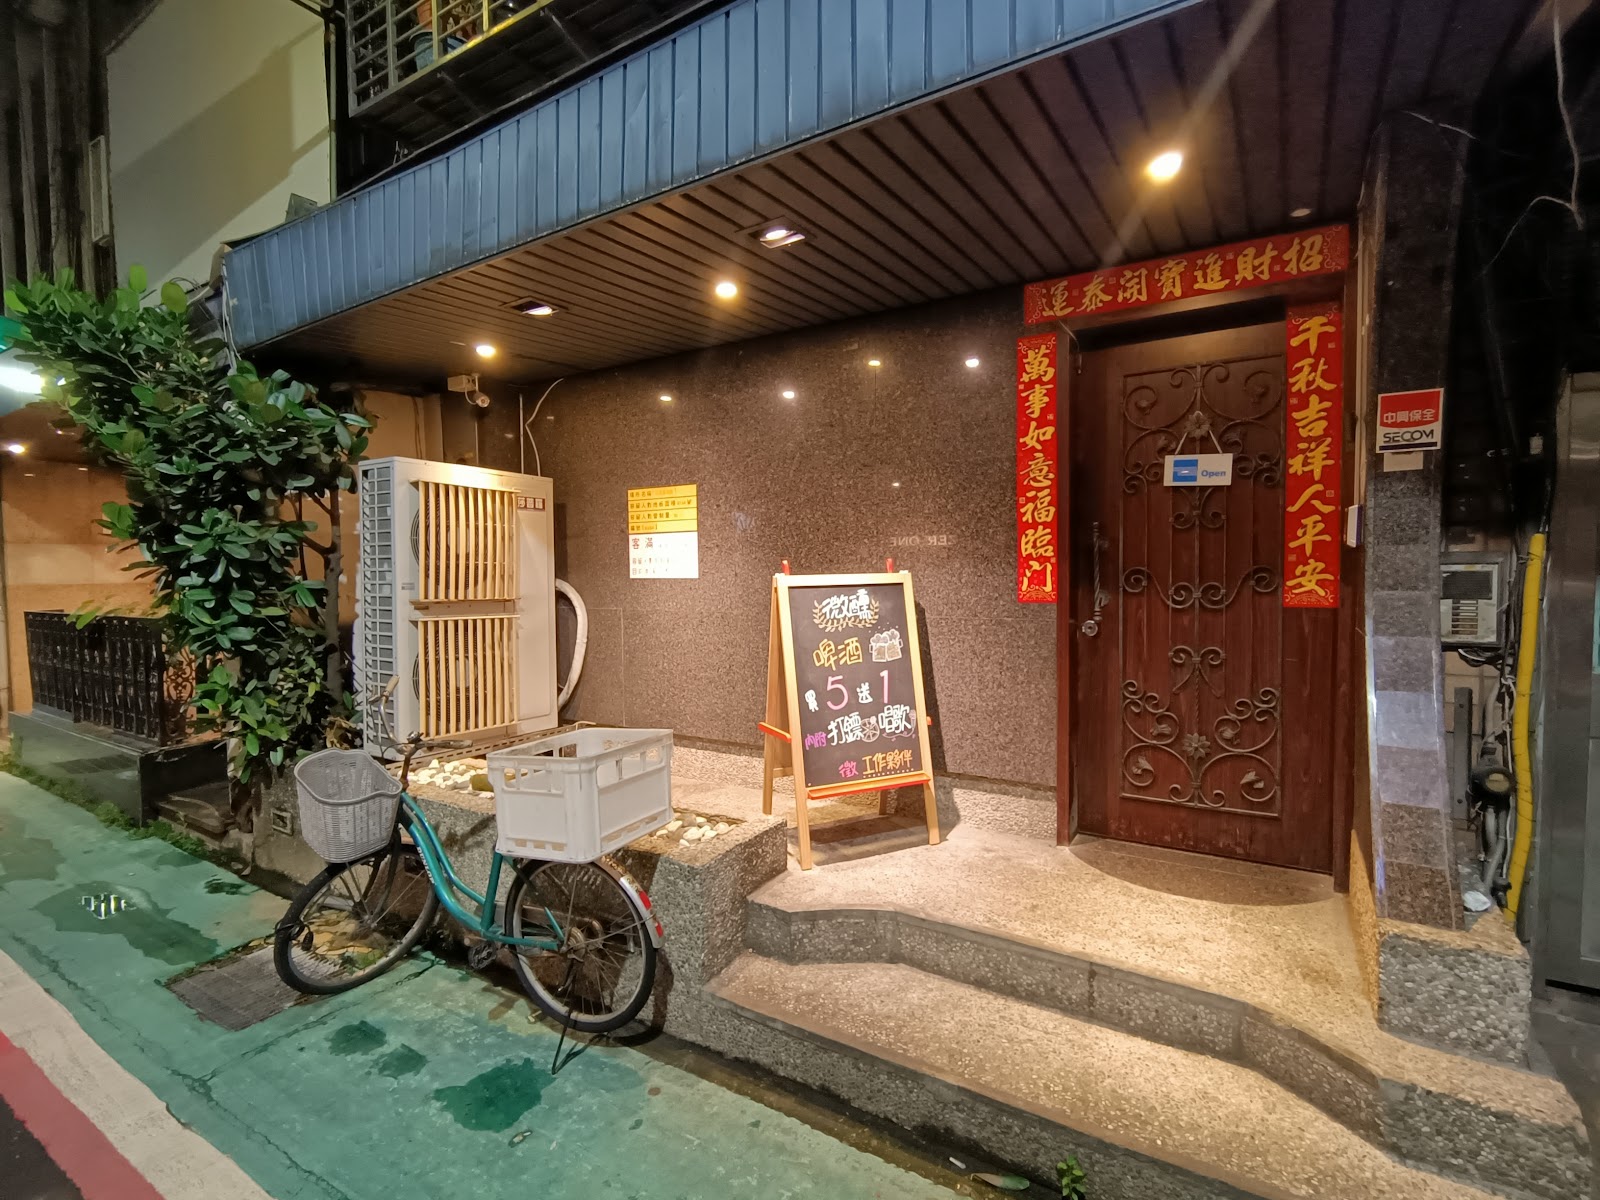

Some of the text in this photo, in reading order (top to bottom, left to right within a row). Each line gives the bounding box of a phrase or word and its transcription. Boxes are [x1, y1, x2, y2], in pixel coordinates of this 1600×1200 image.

[1383, 408, 1435, 424] 中興保全
[1383, 429, 1434, 444] SECOM
[1019, 345, 1056, 593] 萬事如意福臨門
[1286, 316, 1337, 596] 千秋吉祥人平安
[1201, 469, 1226, 478] Open
[813, 637, 862, 671] 啤酒
[878, 704, 912, 734] 唱歌
[862, 749, 913, 774] 工作夥伴
